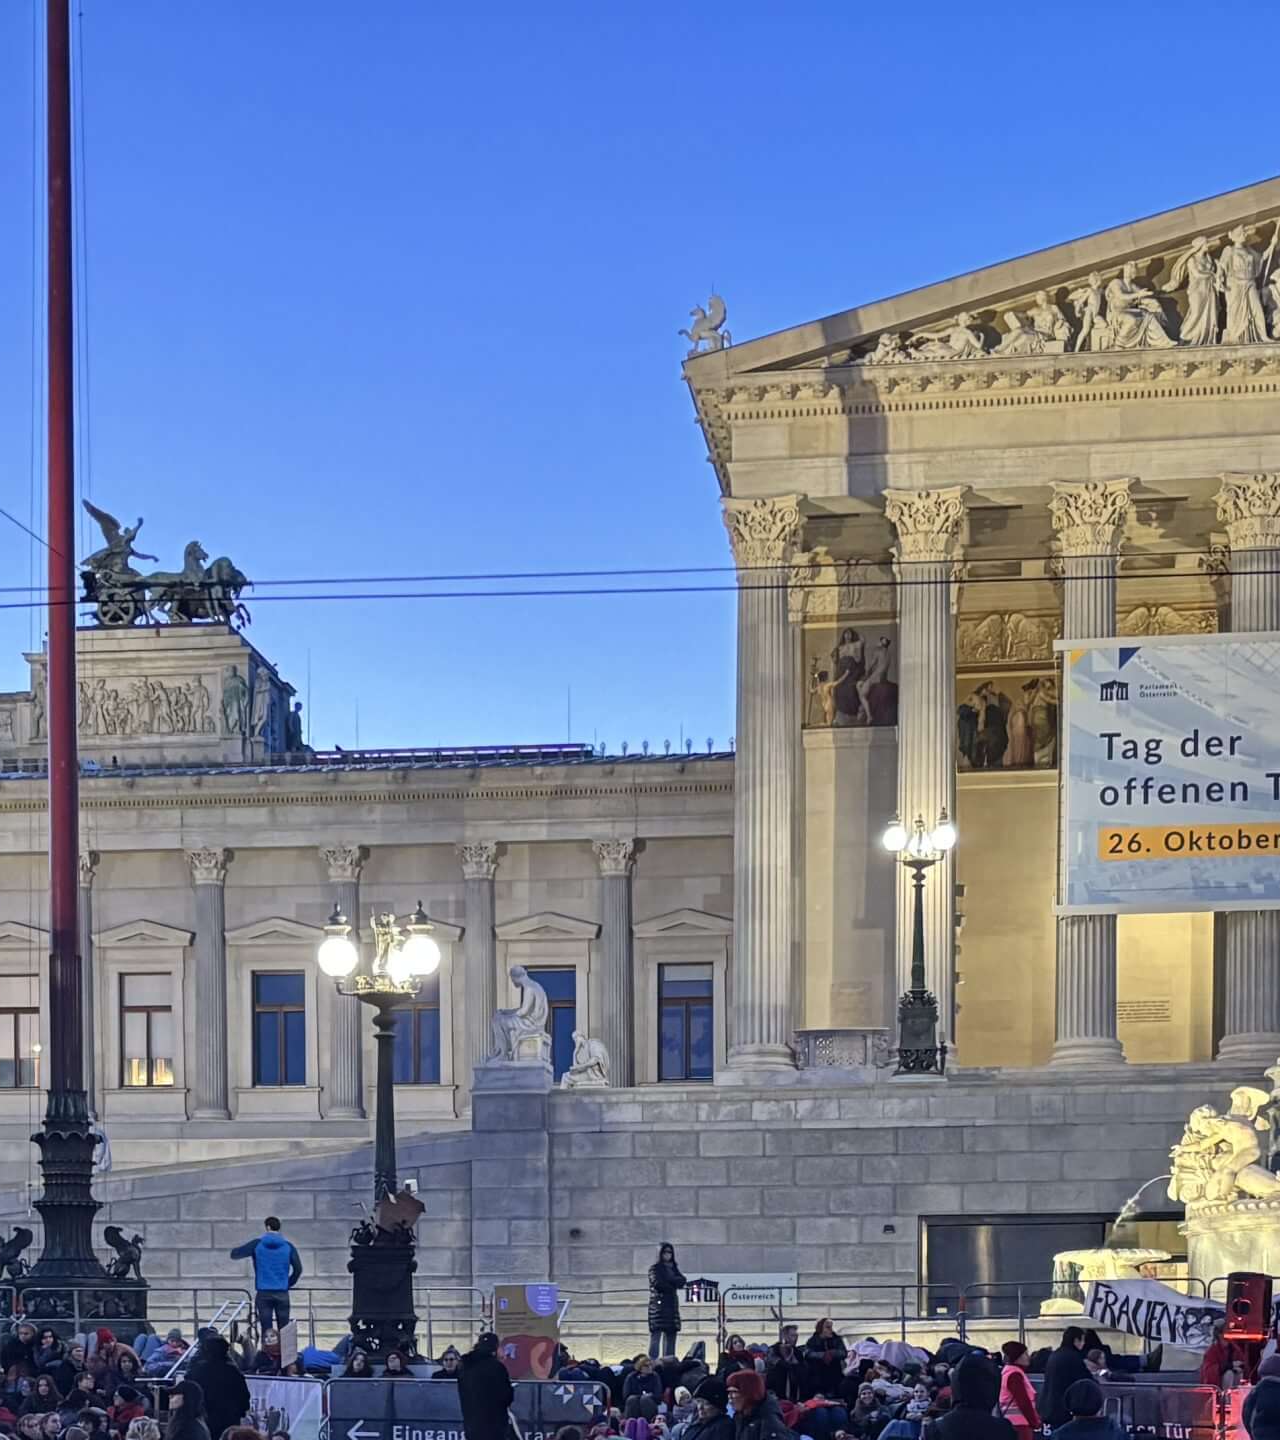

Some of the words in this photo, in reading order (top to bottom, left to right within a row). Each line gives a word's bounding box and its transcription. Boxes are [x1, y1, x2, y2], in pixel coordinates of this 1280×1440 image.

[1099, 732, 1163, 765] Tag
[1179, 728, 1243, 758] der
[1099, 776, 1249, 806] offenen
[1108, 832, 1151, 854] 26.
[731, 1291, 777, 1301] Österreich
[1089, 1281, 1177, 1343] FRAUEN
[1163, 1421, 1193, 1440] Tür
